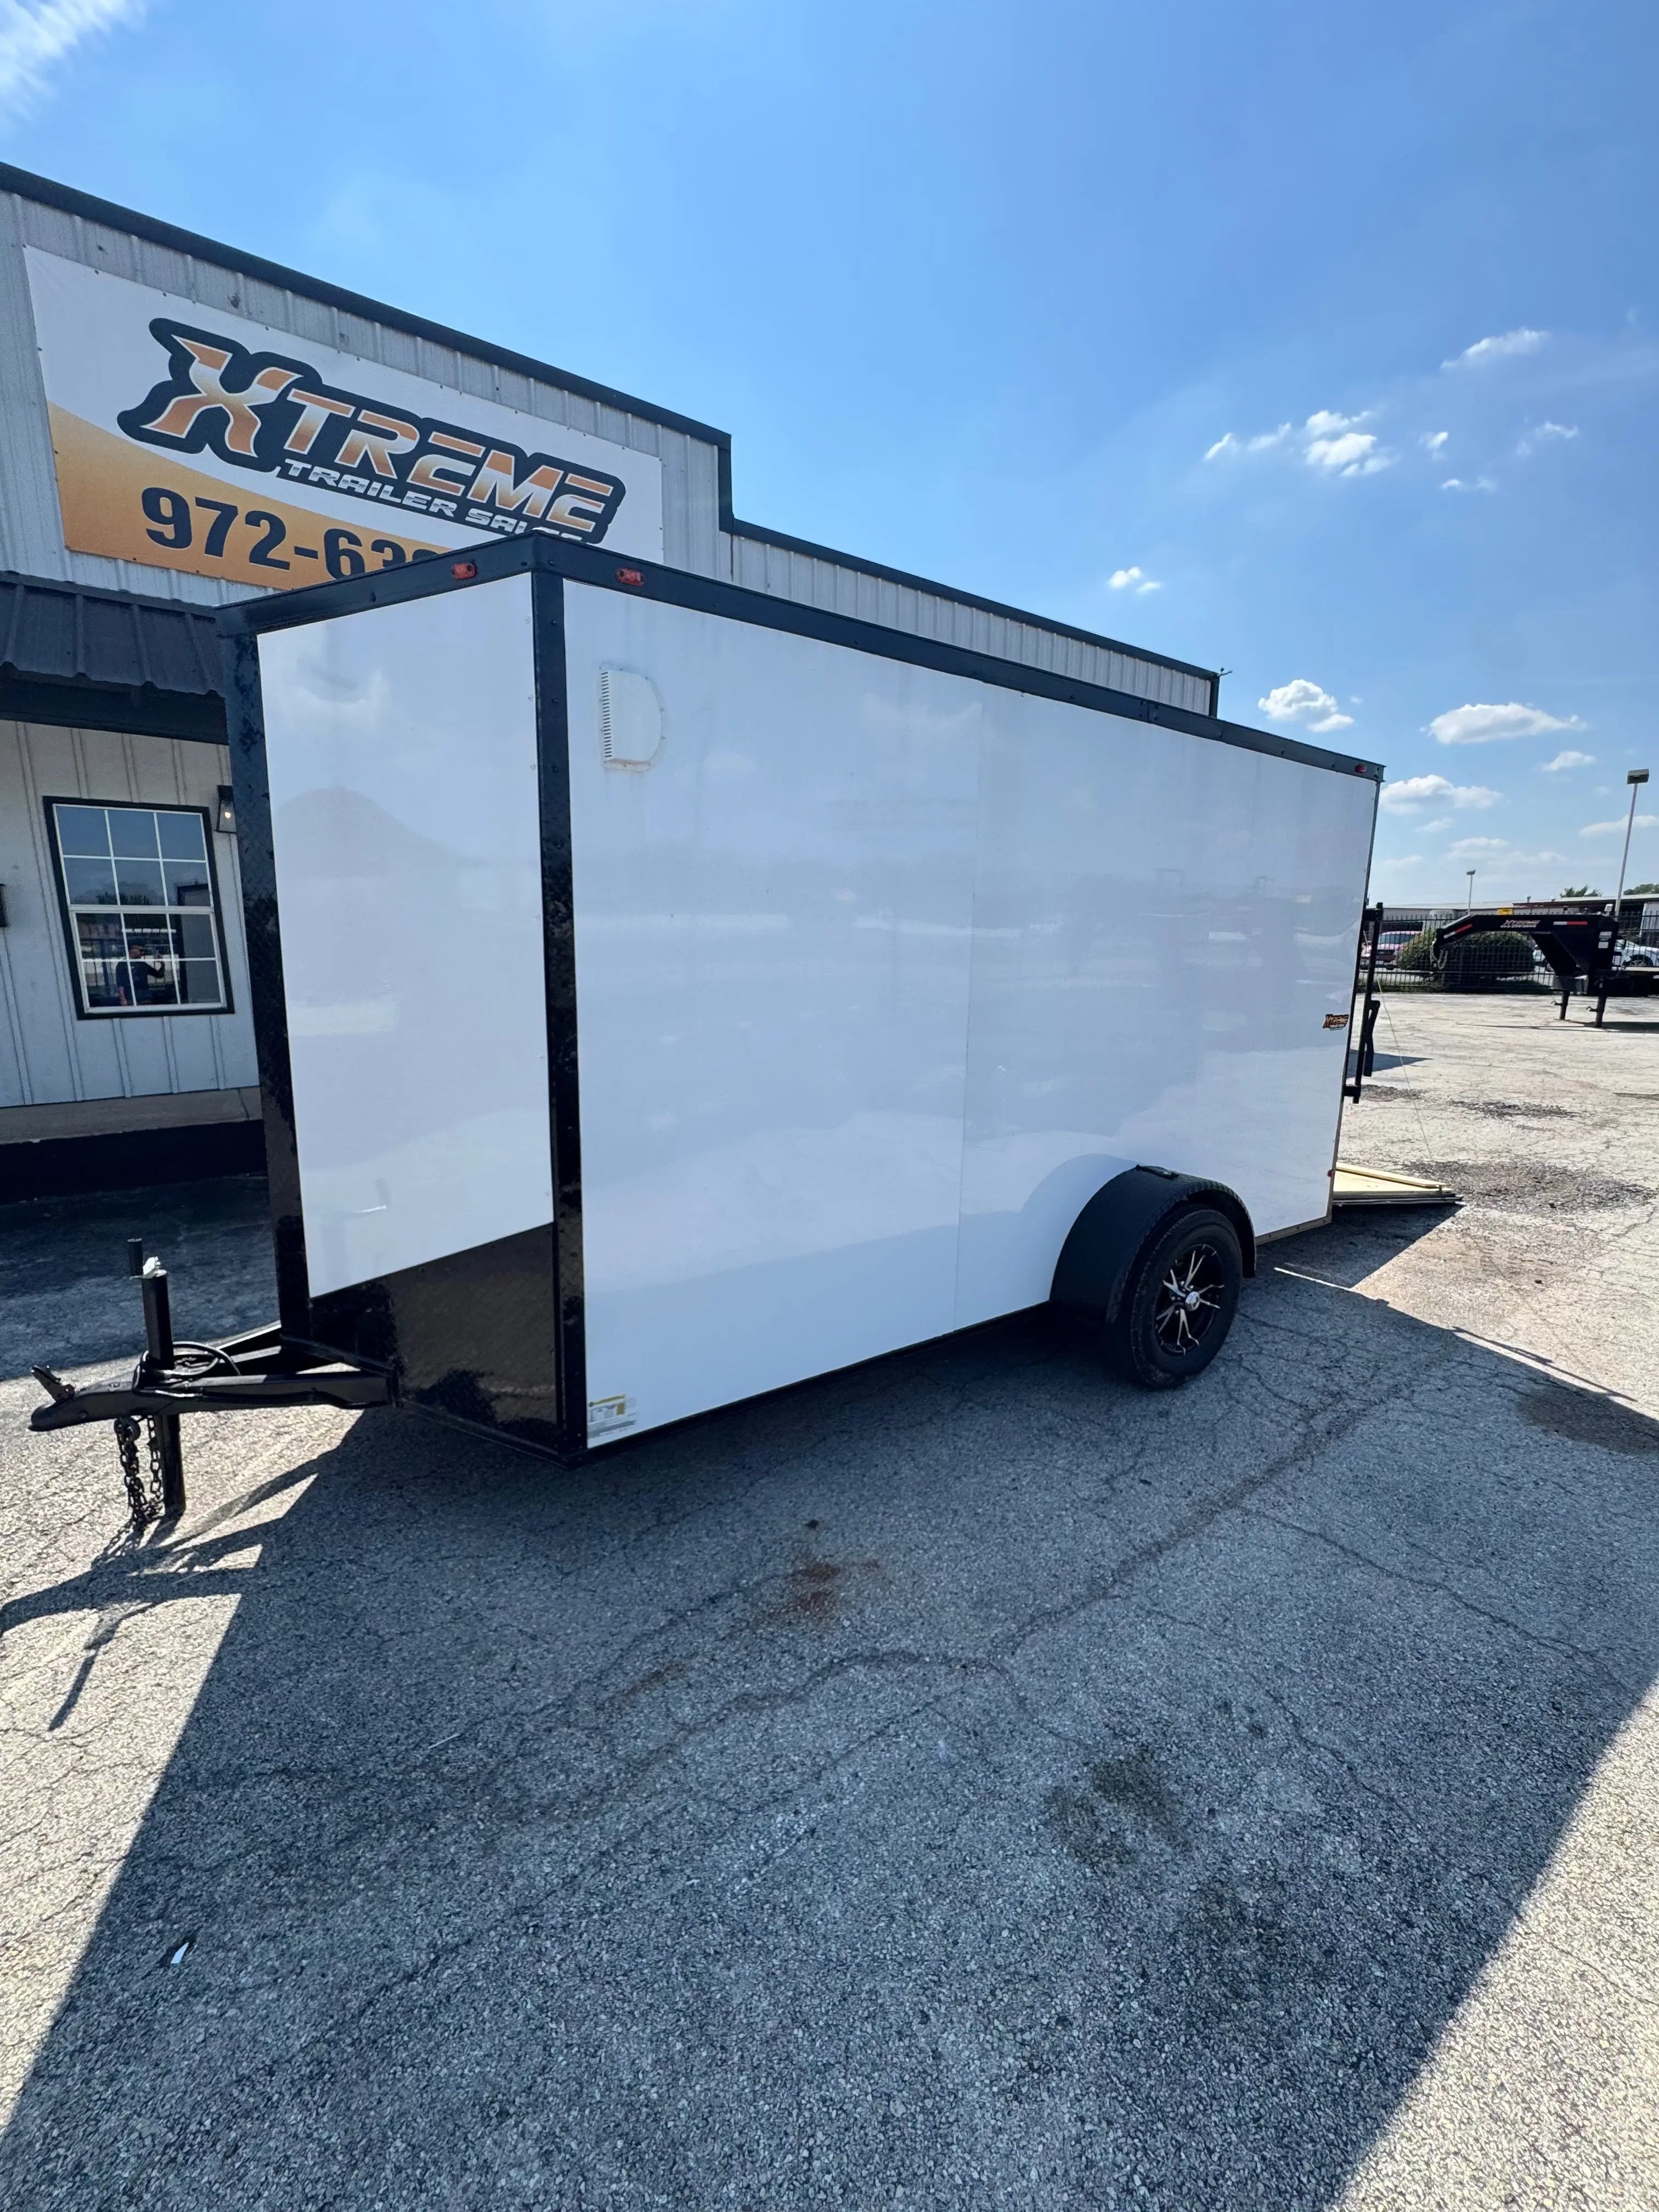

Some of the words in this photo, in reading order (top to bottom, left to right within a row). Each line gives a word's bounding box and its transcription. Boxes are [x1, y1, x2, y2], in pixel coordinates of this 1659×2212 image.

[140, 335, 614, 532] XTREME
[142, 487, 440, 580] 972-63
[284, 458, 456, 517] TRAILER
